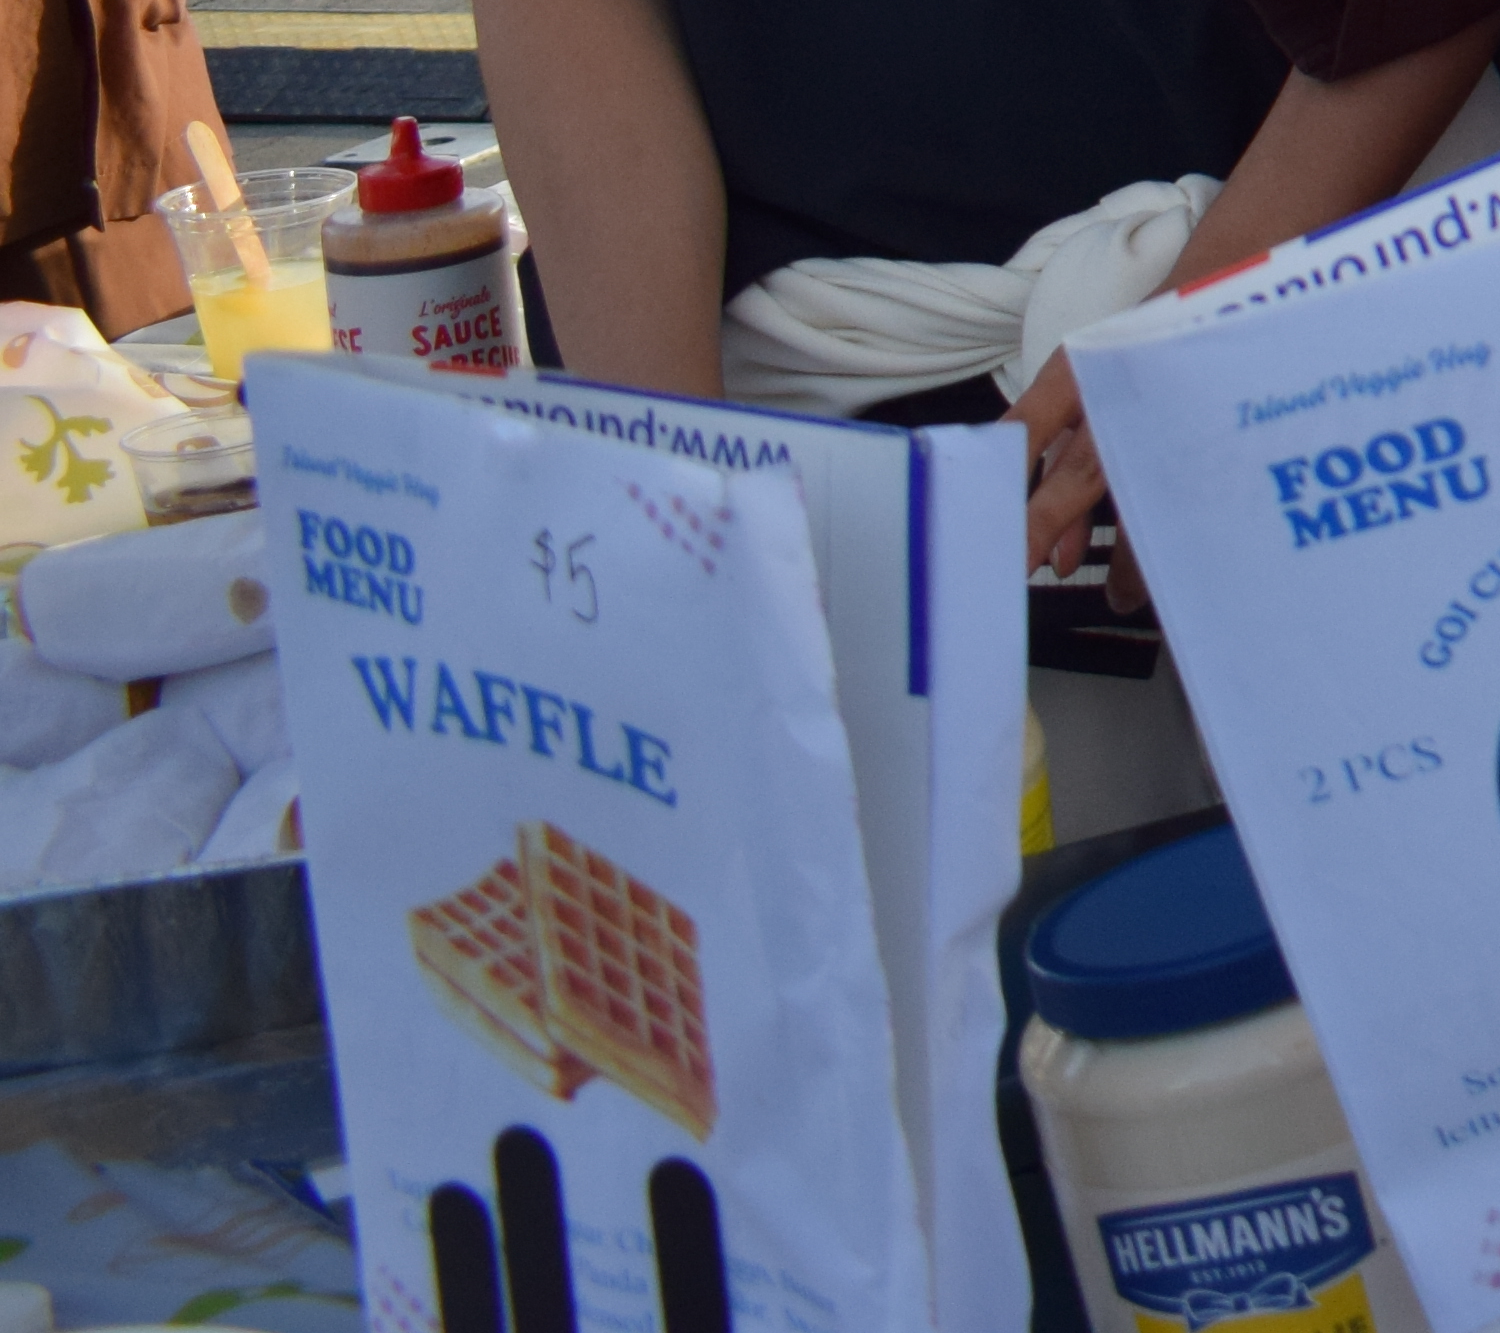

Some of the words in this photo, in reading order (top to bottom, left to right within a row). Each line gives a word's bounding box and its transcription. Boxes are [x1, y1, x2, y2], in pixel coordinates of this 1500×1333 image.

[411, 306, 502, 356] SAUCE
[1267, 416, 1466, 504] FOOD
[296, 507, 416, 577] FOOD
[1284, 454, 1492, 550] MENU
[303, 553, 424, 626] MENU
[530, 527, 599, 625] $5
[1418, 600, 1478, 670] GOI
[351, 655, 678, 810] WAFFLE
[1298, 765, 1332, 804] 2
[1341, 735, 1444, 793] PCS
[1111, 1187, 1351, 1275] HELLMANN'S
